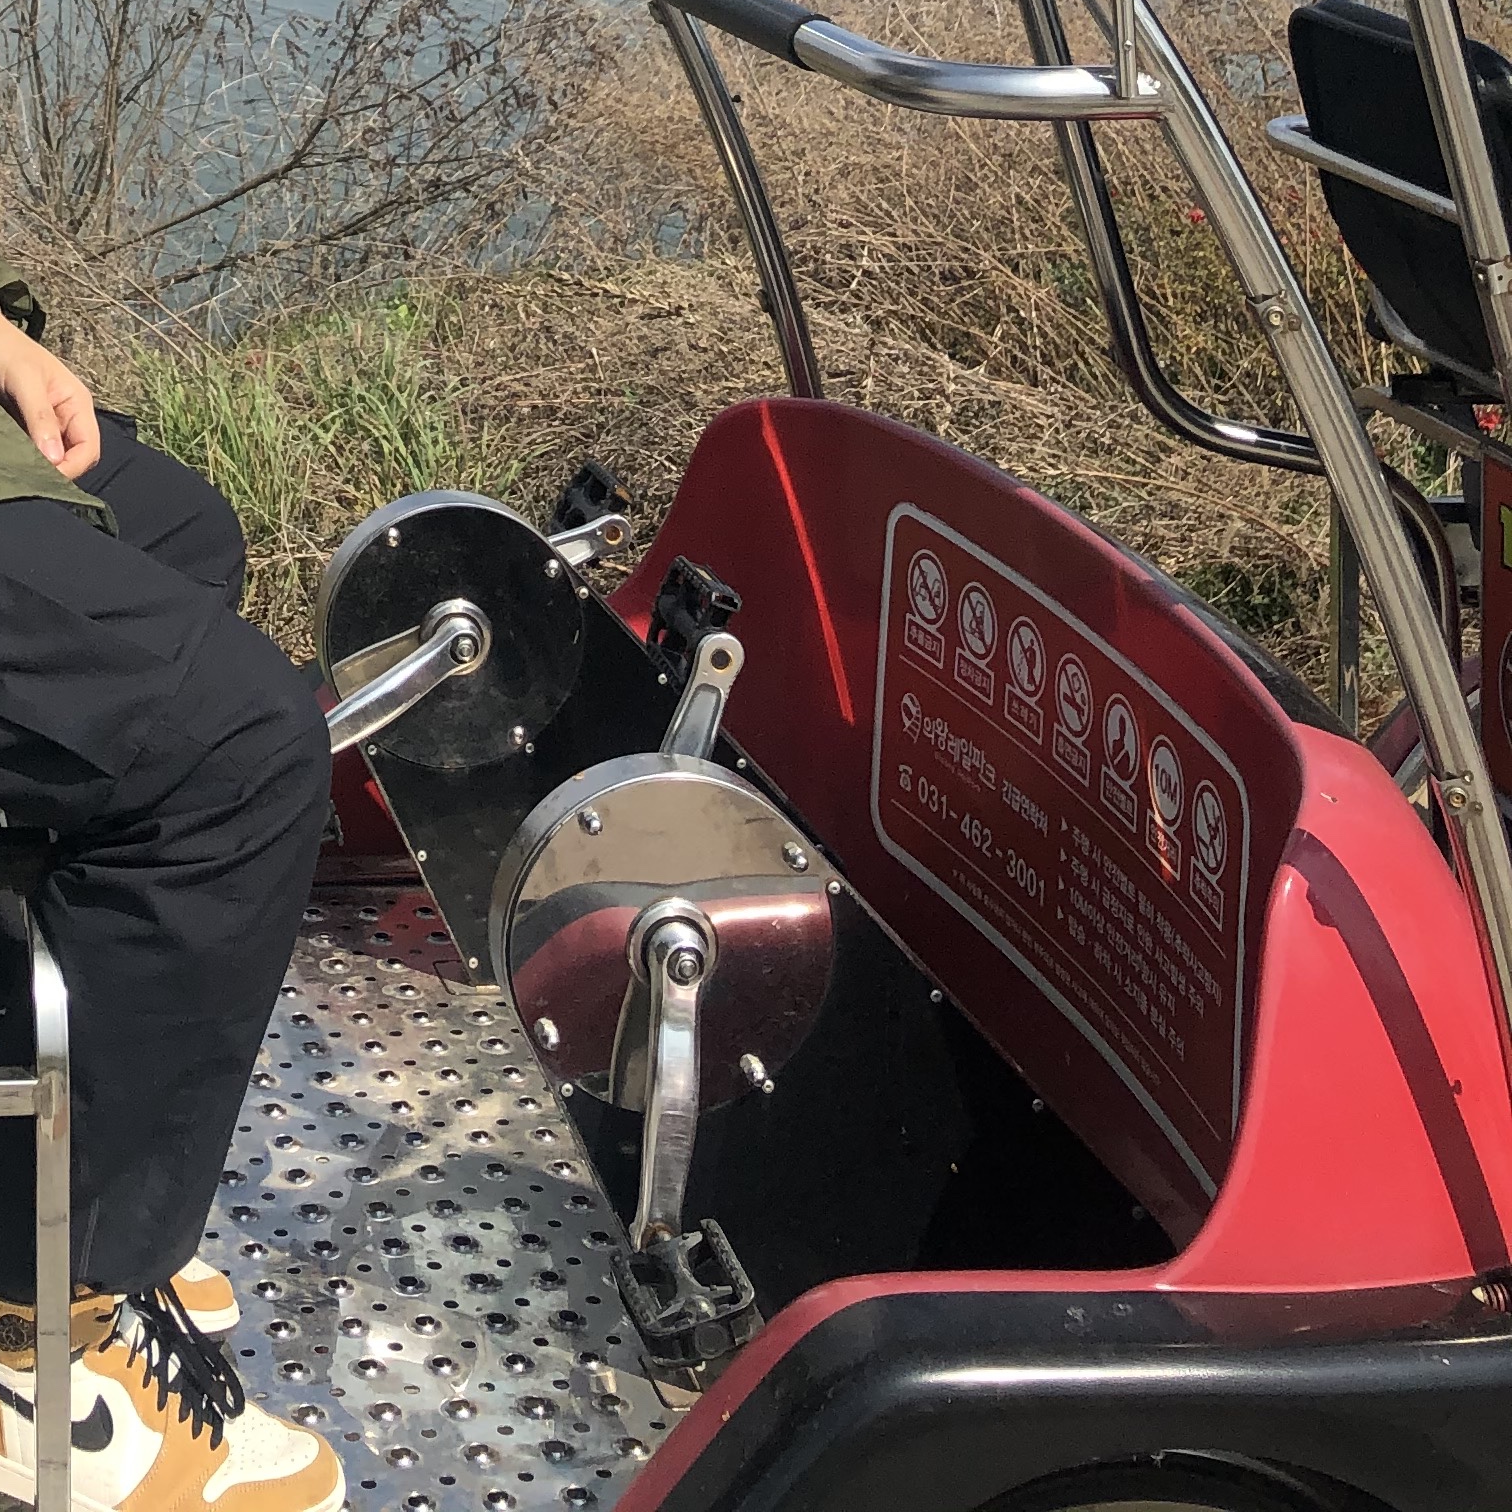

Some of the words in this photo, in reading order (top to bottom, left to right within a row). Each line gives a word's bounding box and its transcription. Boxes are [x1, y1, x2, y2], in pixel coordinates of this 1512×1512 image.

[1011, 698, 1037, 730] 쓰레기
[922, 716, 996, 790] 의왕레일파크
[1001, 777, 1048, 837] 긴급연락처
[1154, 763, 1178, 805] 10M
